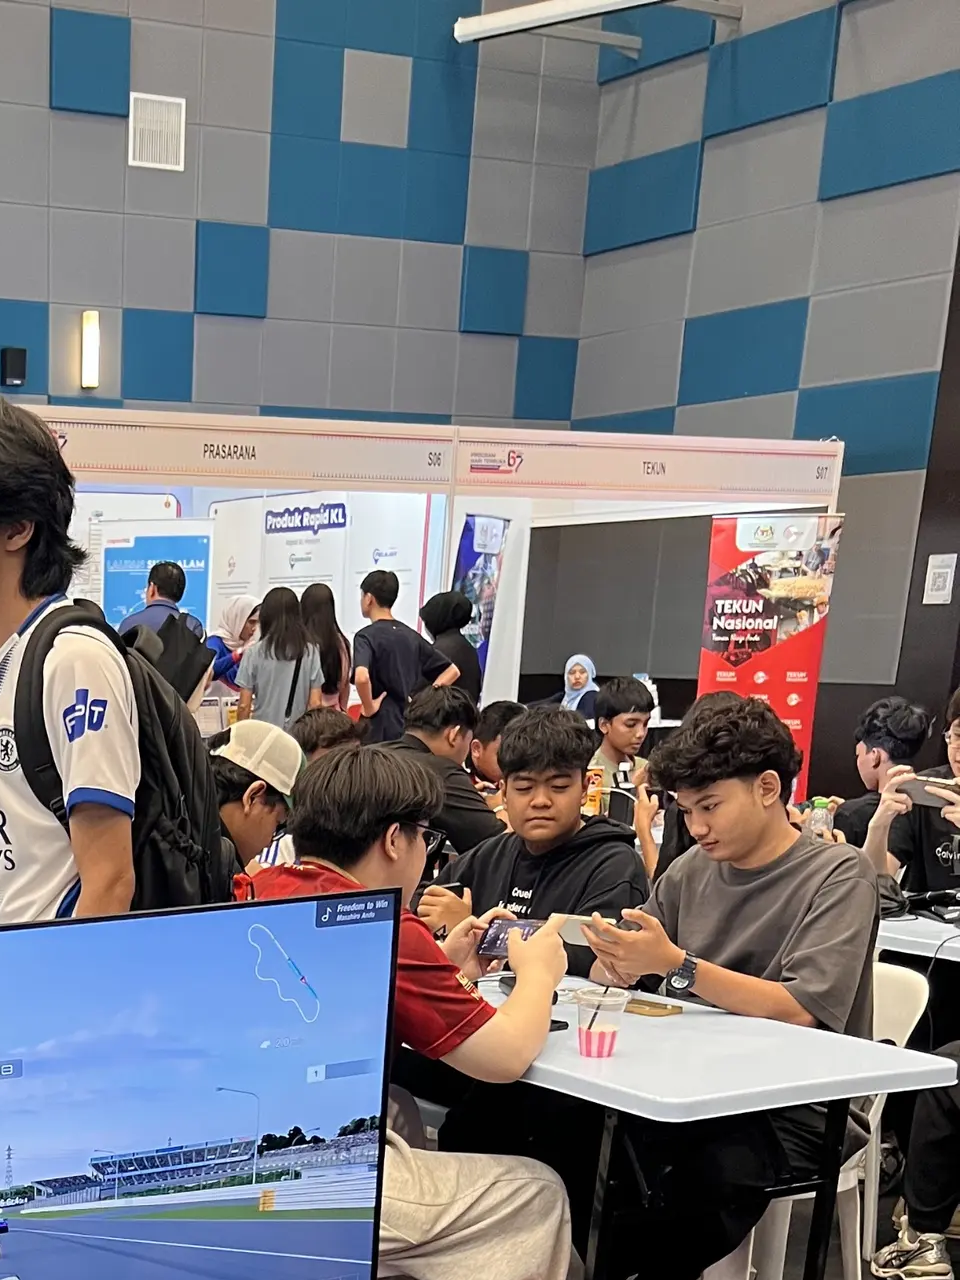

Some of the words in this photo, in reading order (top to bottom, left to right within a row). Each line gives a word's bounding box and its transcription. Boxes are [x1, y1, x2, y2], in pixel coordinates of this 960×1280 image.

[202, 443, 257, 461] PRASARANA
[427, 451, 442, 467] S06
[642, 461, 667, 476] TEKUN
[815, 466, 829, 480] S07
[266, 512, 302, 529] Produk
[302, 507, 330, 530] Rapid
[330, 508, 345, 524] KL
[715, 599, 764, 614] TEKUN
[712, 615, 778, 630] Nasional
[511, 886, 533, 899] Cruel
[336, 902, 365, 913] Freedom
[367, 902, 374, 910] to
[375, 899, 389, 909] Win
